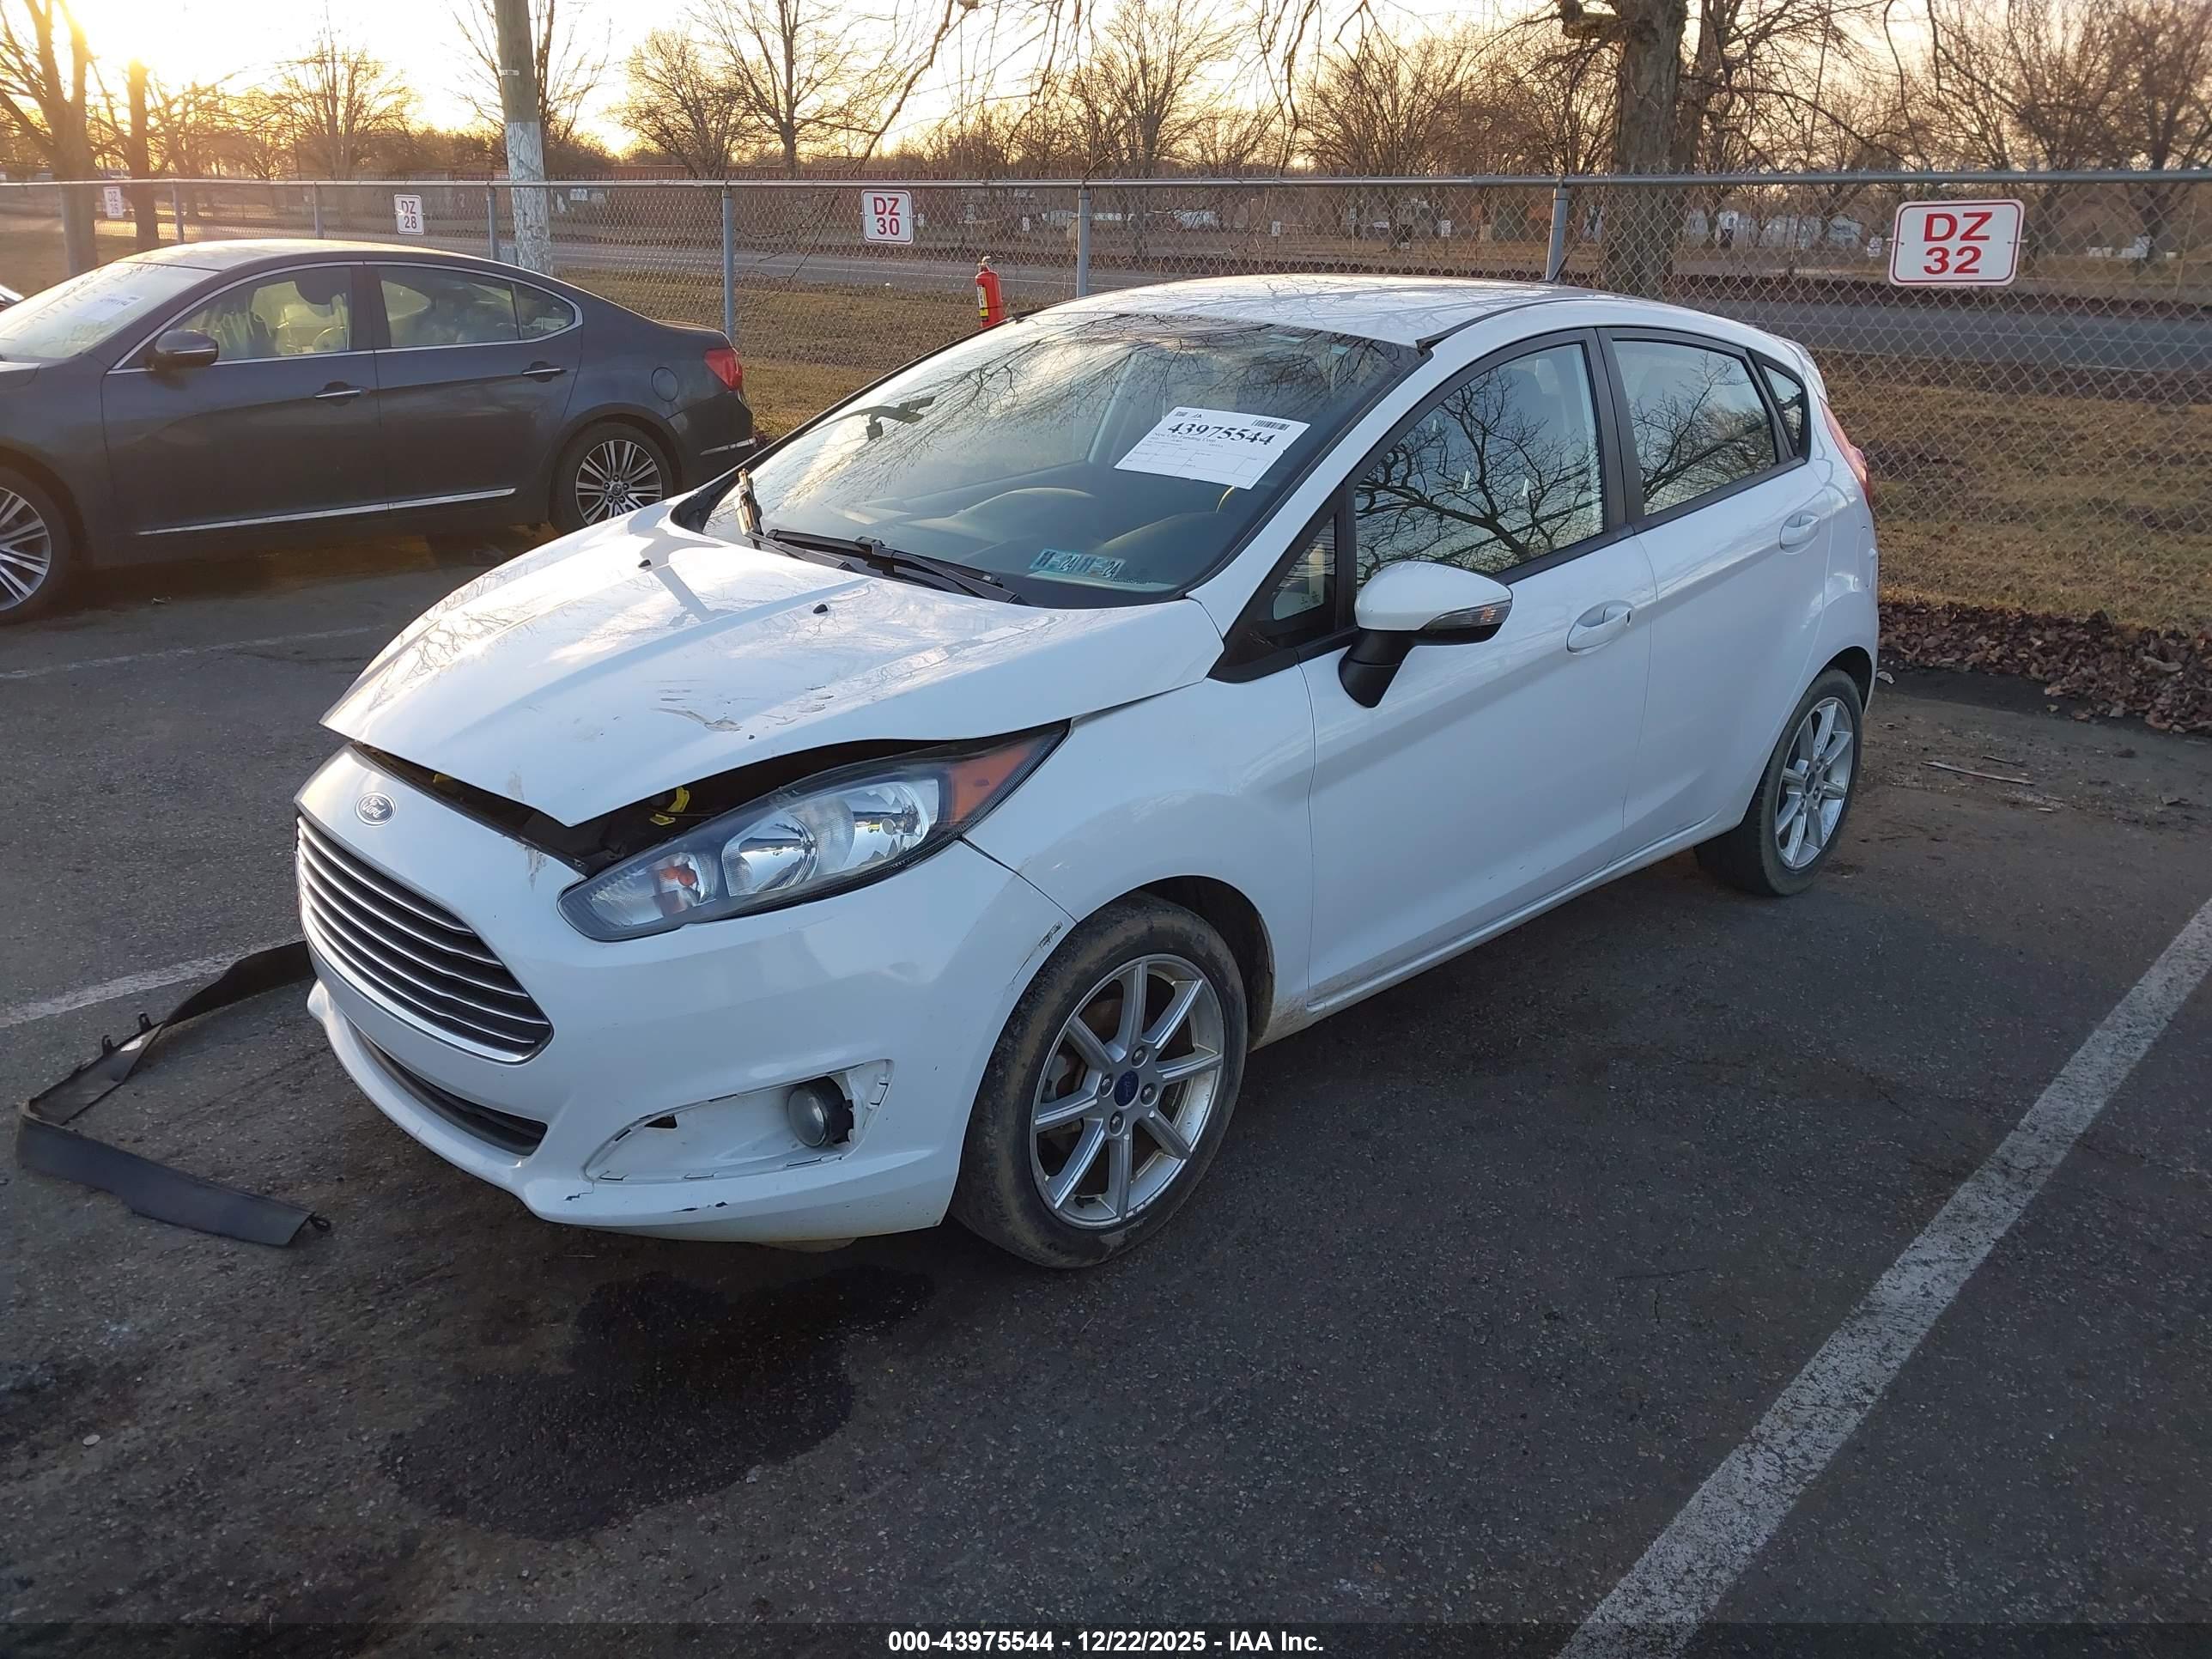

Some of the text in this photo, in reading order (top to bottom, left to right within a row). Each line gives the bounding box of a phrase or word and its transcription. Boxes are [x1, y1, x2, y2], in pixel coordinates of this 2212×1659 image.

[401, 200, 416, 215] DZ
[872, 197, 901, 216] DZ
[404, 216, 417, 229] 28
[876, 217, 900, 236] 30
[1923, 211, 1993, 242] DZ
[1923, 246, 1982, 275] 32
[1167, 422, 1276, 446] 43975544
[1059, 555, 1079, 571] 24
[361, 798, 386, 818] Ford
